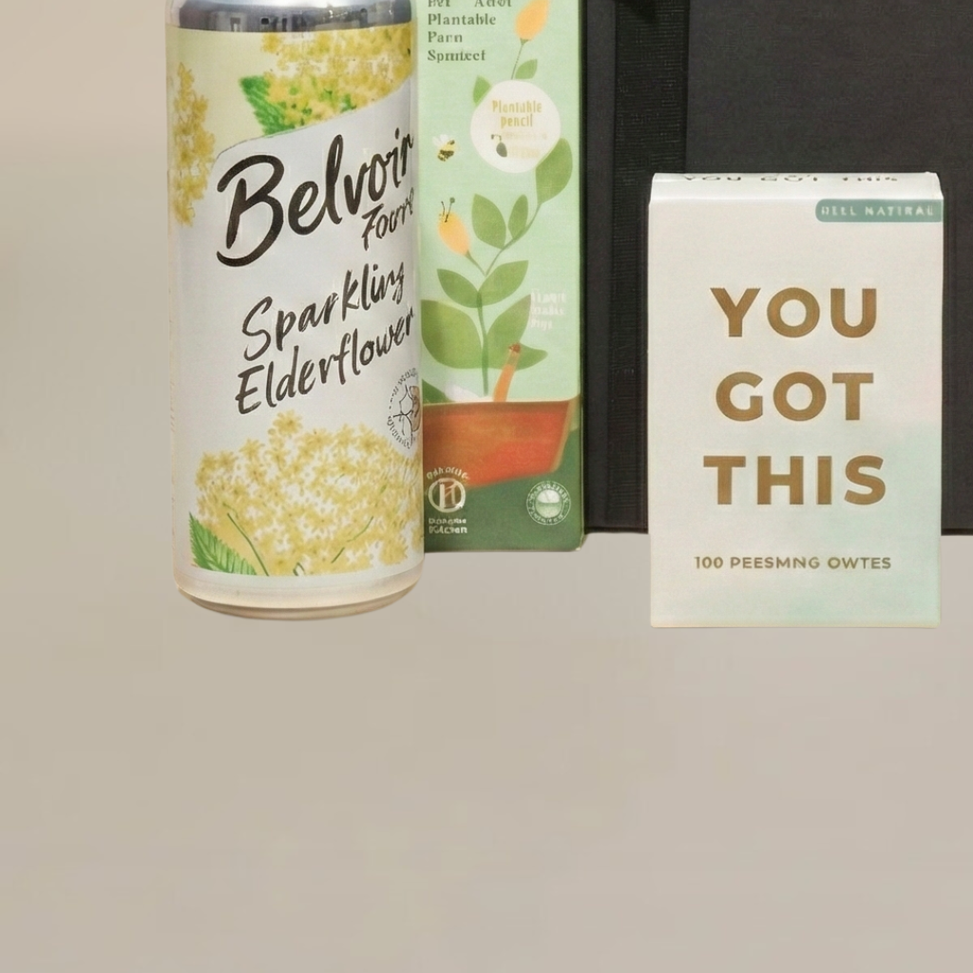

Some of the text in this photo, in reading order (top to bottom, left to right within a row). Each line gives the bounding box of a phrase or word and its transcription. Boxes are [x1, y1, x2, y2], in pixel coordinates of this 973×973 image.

[216, 127, 414, 267] Belvoir
[242, 261, 404, 362] Sparkling
[710, 287, 876, 338] YOU
[235, 306, 415, 415] Elderflower
[716, 371, 874, 421] GOT
[703, 455, 886, 505] THIS
[694, 556, 723, 569] 100
